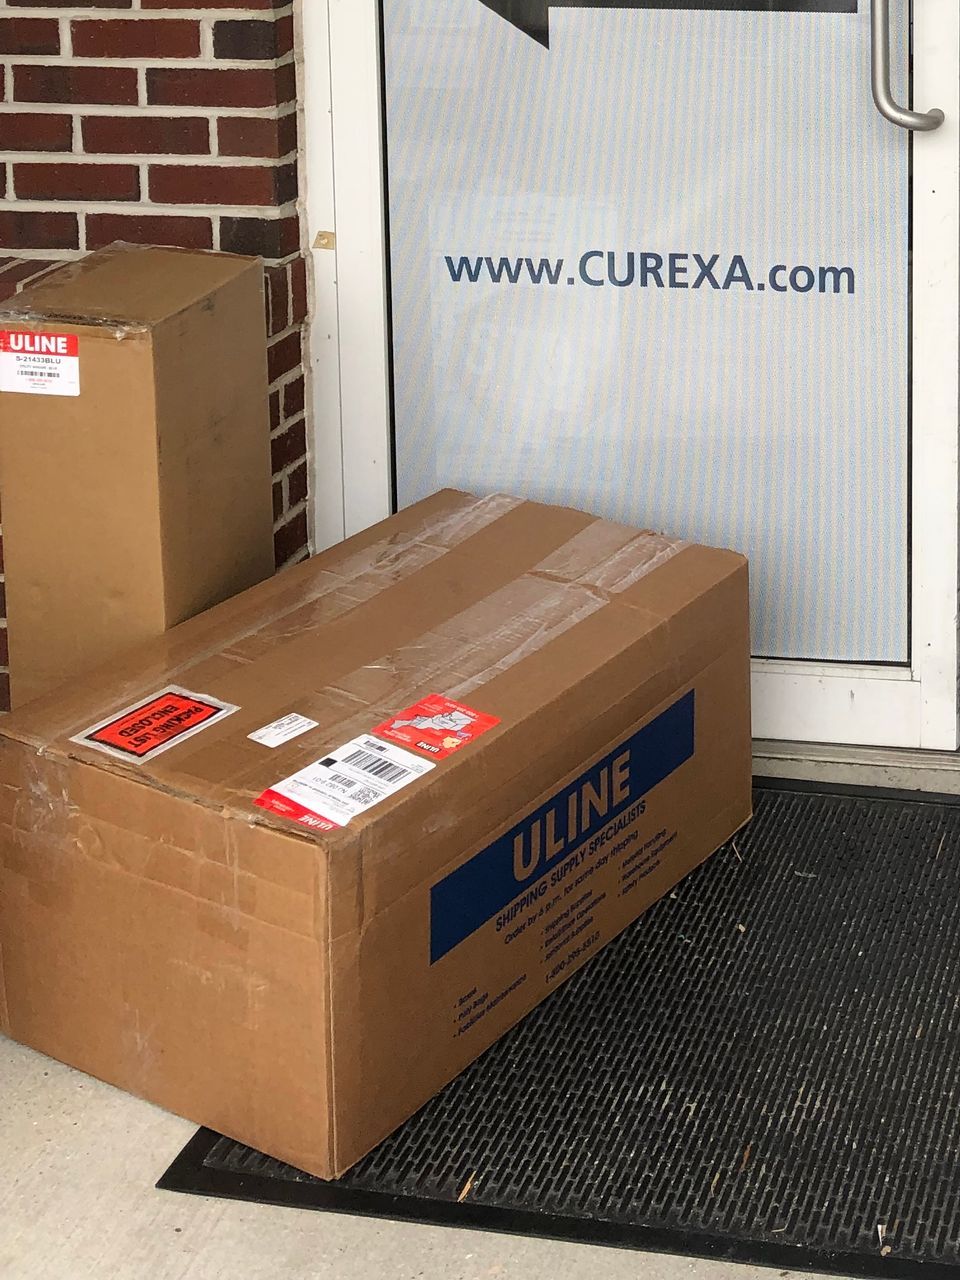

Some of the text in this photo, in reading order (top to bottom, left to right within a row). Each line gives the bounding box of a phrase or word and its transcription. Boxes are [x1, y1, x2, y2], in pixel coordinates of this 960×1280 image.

[444, 250, 855, 294] www.CUREXA.com
[10, 333, 67, 354] ULINE
[118, 705, 180, 737] ENCLOSED
[152, 706, 204, 733] PACKING
[128, 731, 157, 748] LIST
[417, 741, 440, 754] ULINE
[297, 815, 333, 831] ULINE
[513, 749, 630, 882] ULINE
[495, 880, 547, 932] SHIPPING
[551, 848, 586, 887] SUPPLY
[588, 800, 646, 855] SPECIALISTS
